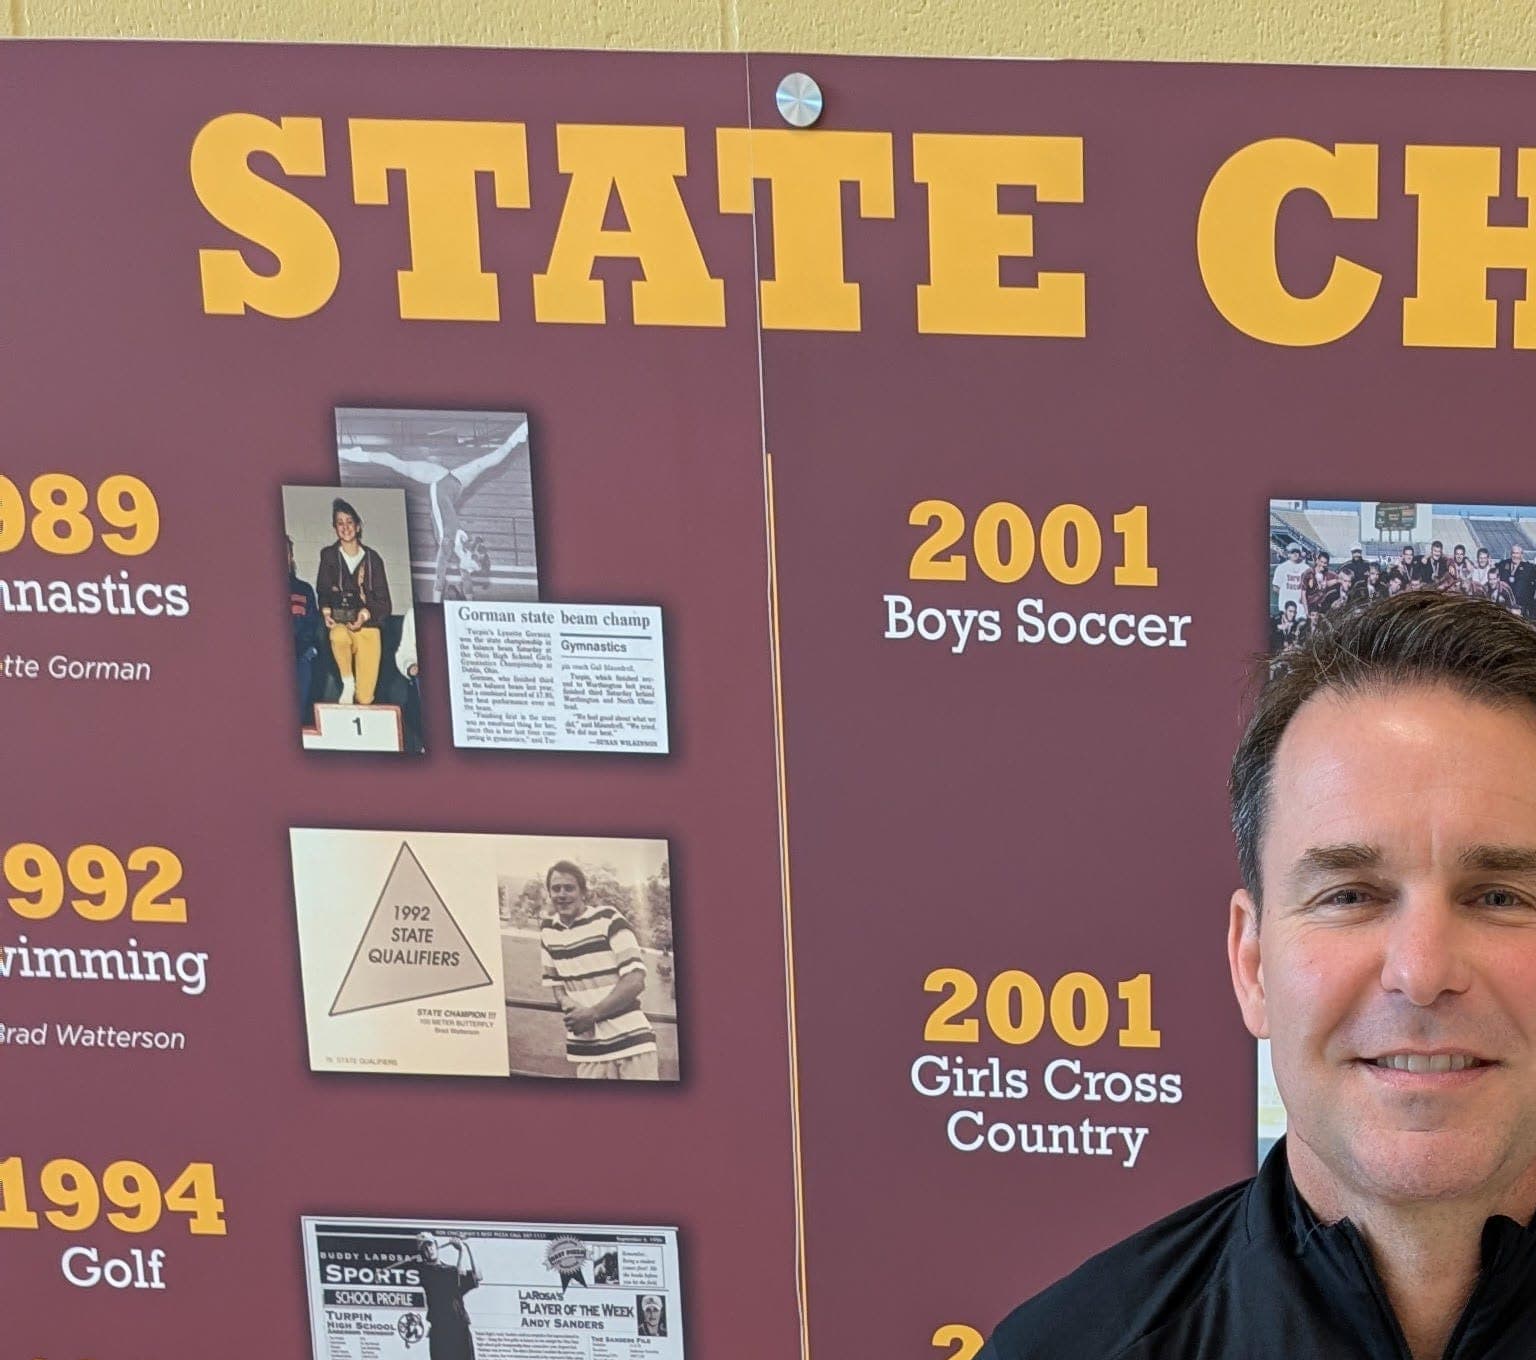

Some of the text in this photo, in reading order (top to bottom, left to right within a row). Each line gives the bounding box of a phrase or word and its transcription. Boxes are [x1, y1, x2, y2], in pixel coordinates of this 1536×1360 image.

[190, 113, 1086, 338] STATE
[909, 499, 1158, 587] 2001
[458, 606, 651, 630] Gorman state beam champ
[883, 594, 1192, 653] Boys Soccer
[561, 639, 627, 653] Gymnastics
[48, 654, 151, 681] Gorman
[352, 717, 362, 736] 1
[3, 842, 187, 923] 992
[393, 904, 431, 921] 1992
[391, 927, 434, 943] STATE
[368, 948, 460, 967] QUALIFIERS
[923, 967, 1161, 1048] 2001
[56, 1024, 186, 1049] Watterson
[911, 1054, 1183, 1103] Girls Cross
[947, 1111, 1149, 1167] Country
[0, 1156, 227, 1234] 1994
[61, 1246, 166, 1289] Golf
[335, 1291, 376, 1305] SCHOOL
